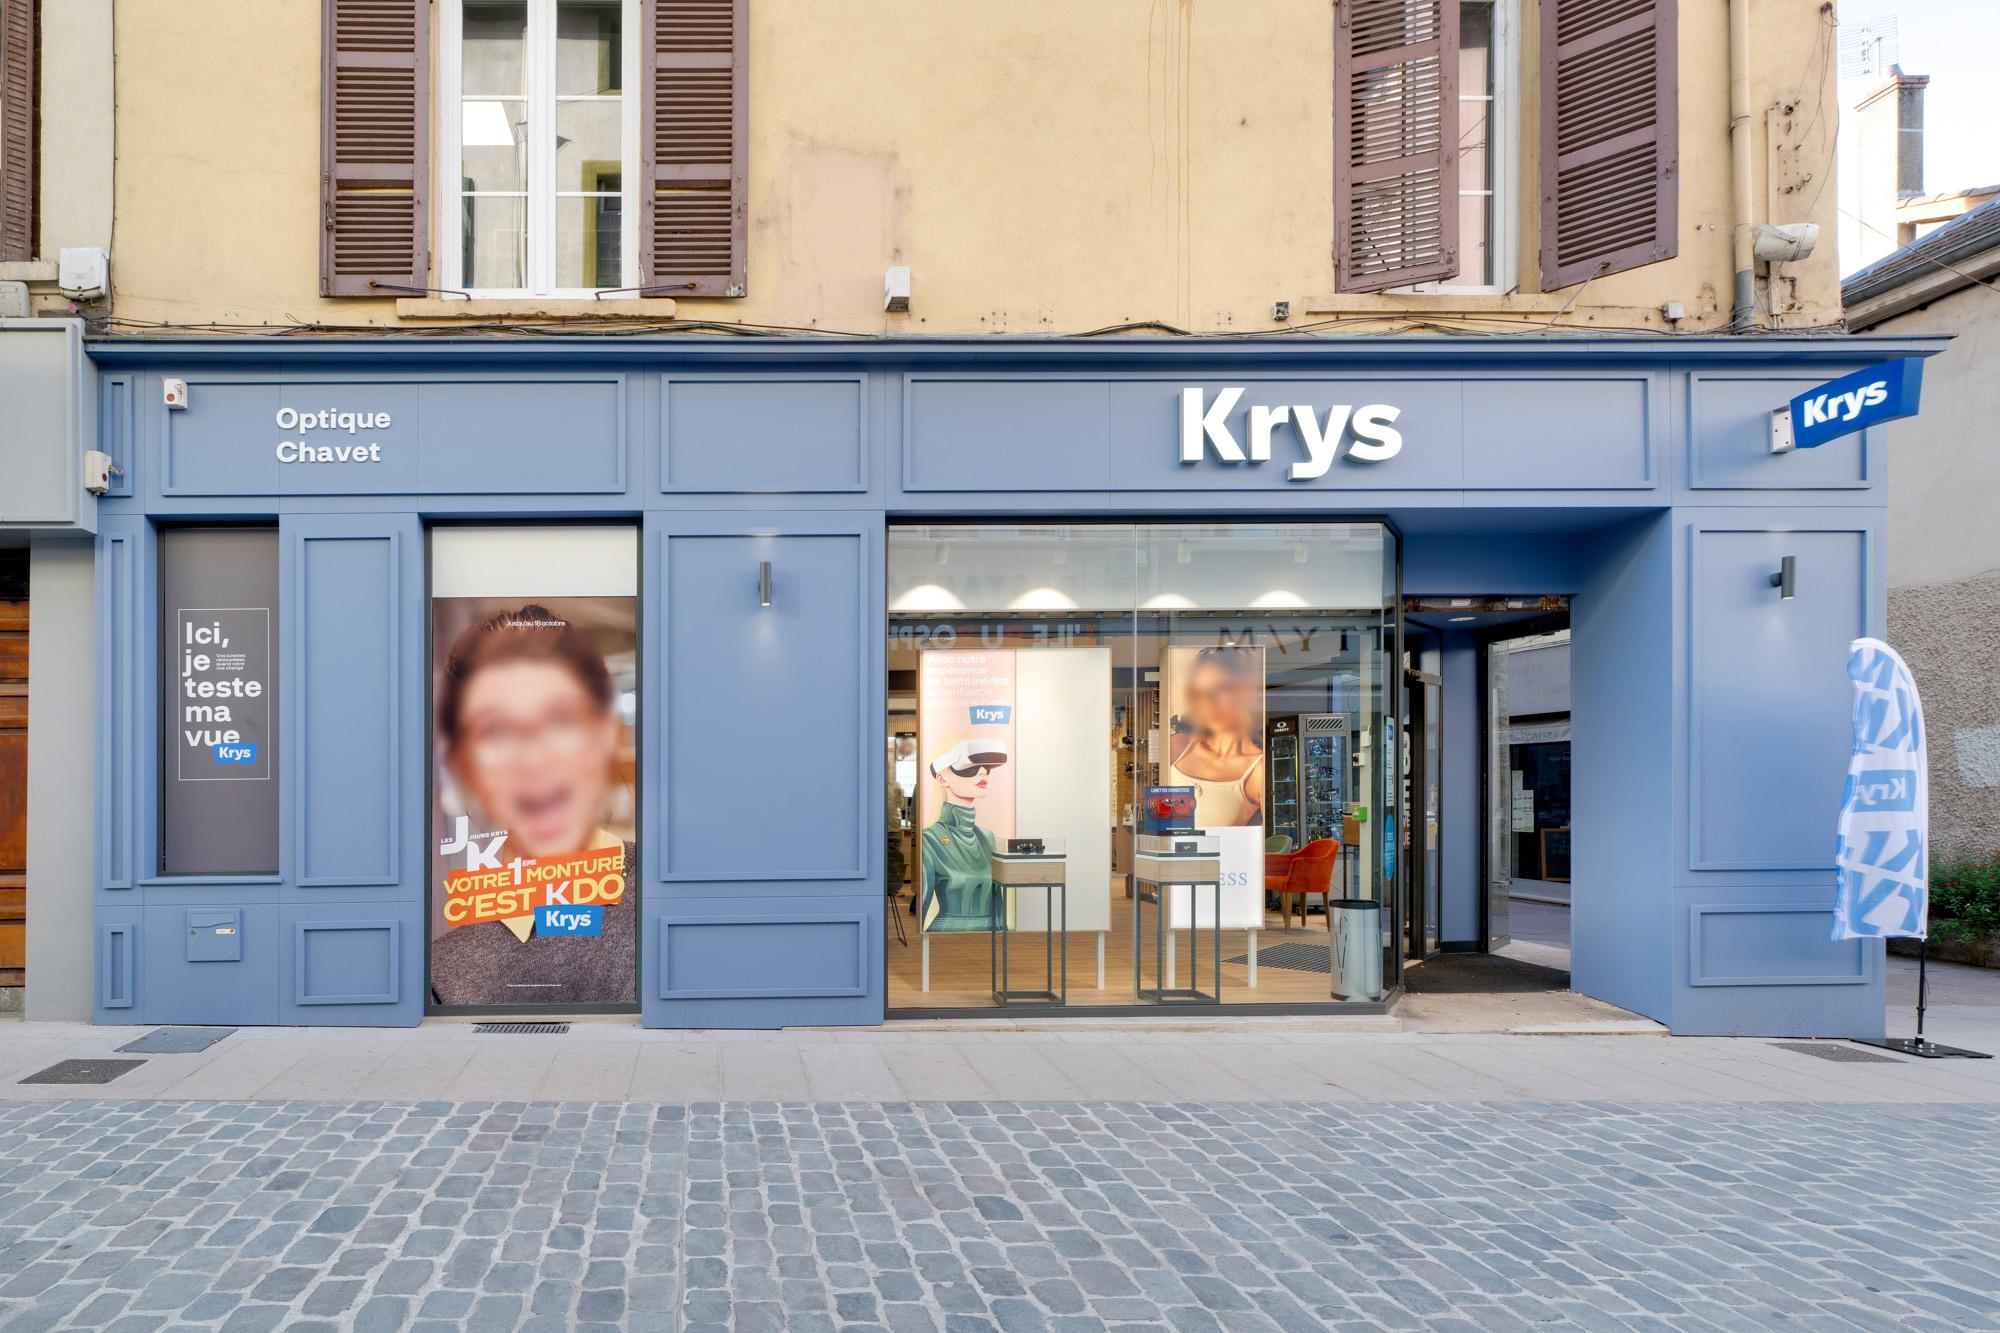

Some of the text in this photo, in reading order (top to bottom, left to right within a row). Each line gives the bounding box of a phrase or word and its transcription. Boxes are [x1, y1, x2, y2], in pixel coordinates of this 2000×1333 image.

[1804, 380, 1888, 428] Krys
[276, 407, 392, 434] Optique
[1180, 387, 1403, 480] Krys
[276, 441, 381, 463] Chavet
[186, 621, 230, 648] Ici,
[182, 649, 211, 677] je
[184, 677, 262, 698] teste
[185, 705, 232, 723] ma
[976, 708, 1005, 721] Krys
[184, 729, 240, 747] vue
[219, 746, 252, 761] Krys
[469, 832, 490, 840] JOURS
[443, 871, 511, 894] VOTRE
[526, 855, 624, 883] MONTURE
[1220, 872, 1248, 887] ESS
[443, 887, 537, 922] C'EST
[546, 910, 592, 930] Krys
